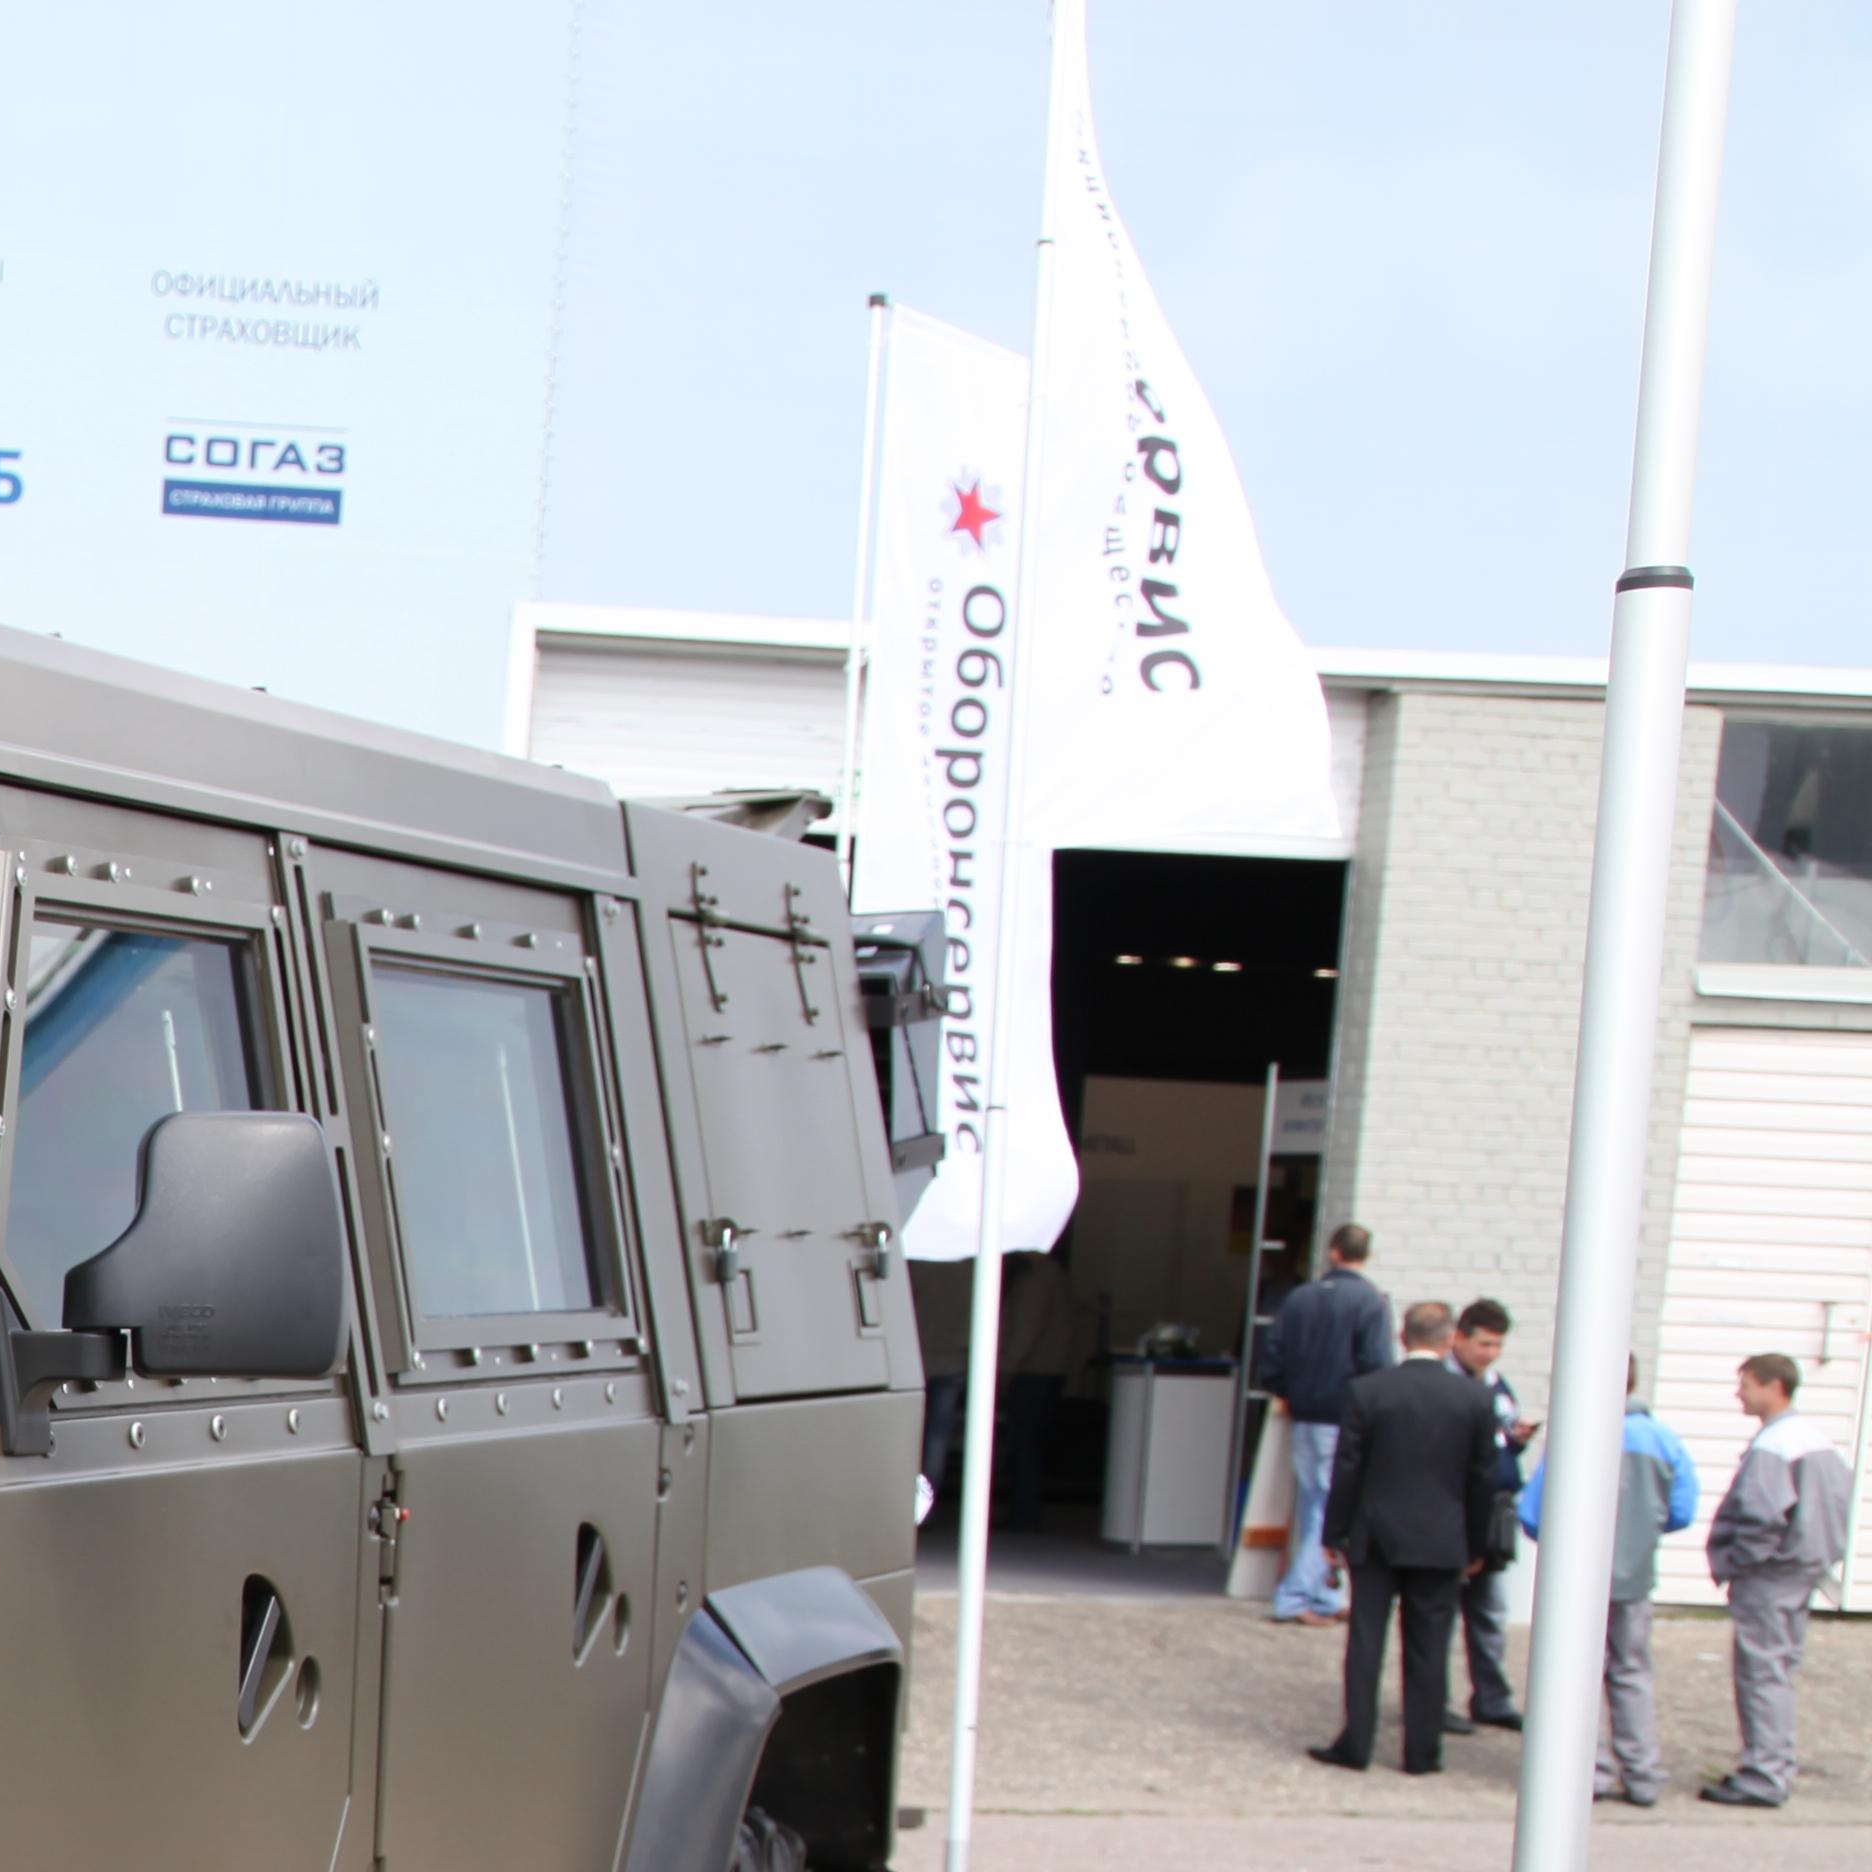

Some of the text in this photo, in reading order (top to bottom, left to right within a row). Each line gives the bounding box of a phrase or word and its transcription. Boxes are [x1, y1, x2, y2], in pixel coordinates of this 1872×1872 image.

[150, 270, 380, 310] ОФИЦИАЛЬНЫЙ
[164, 312, 362, 352] СТРАХОВЩИК
[165, 434, 345, 474] СОГАЗ
[168, 488, 335, 515] СТРАХОВАЯ ГРУППА
[934, 584, 1006, 1154] Оборонсервис
